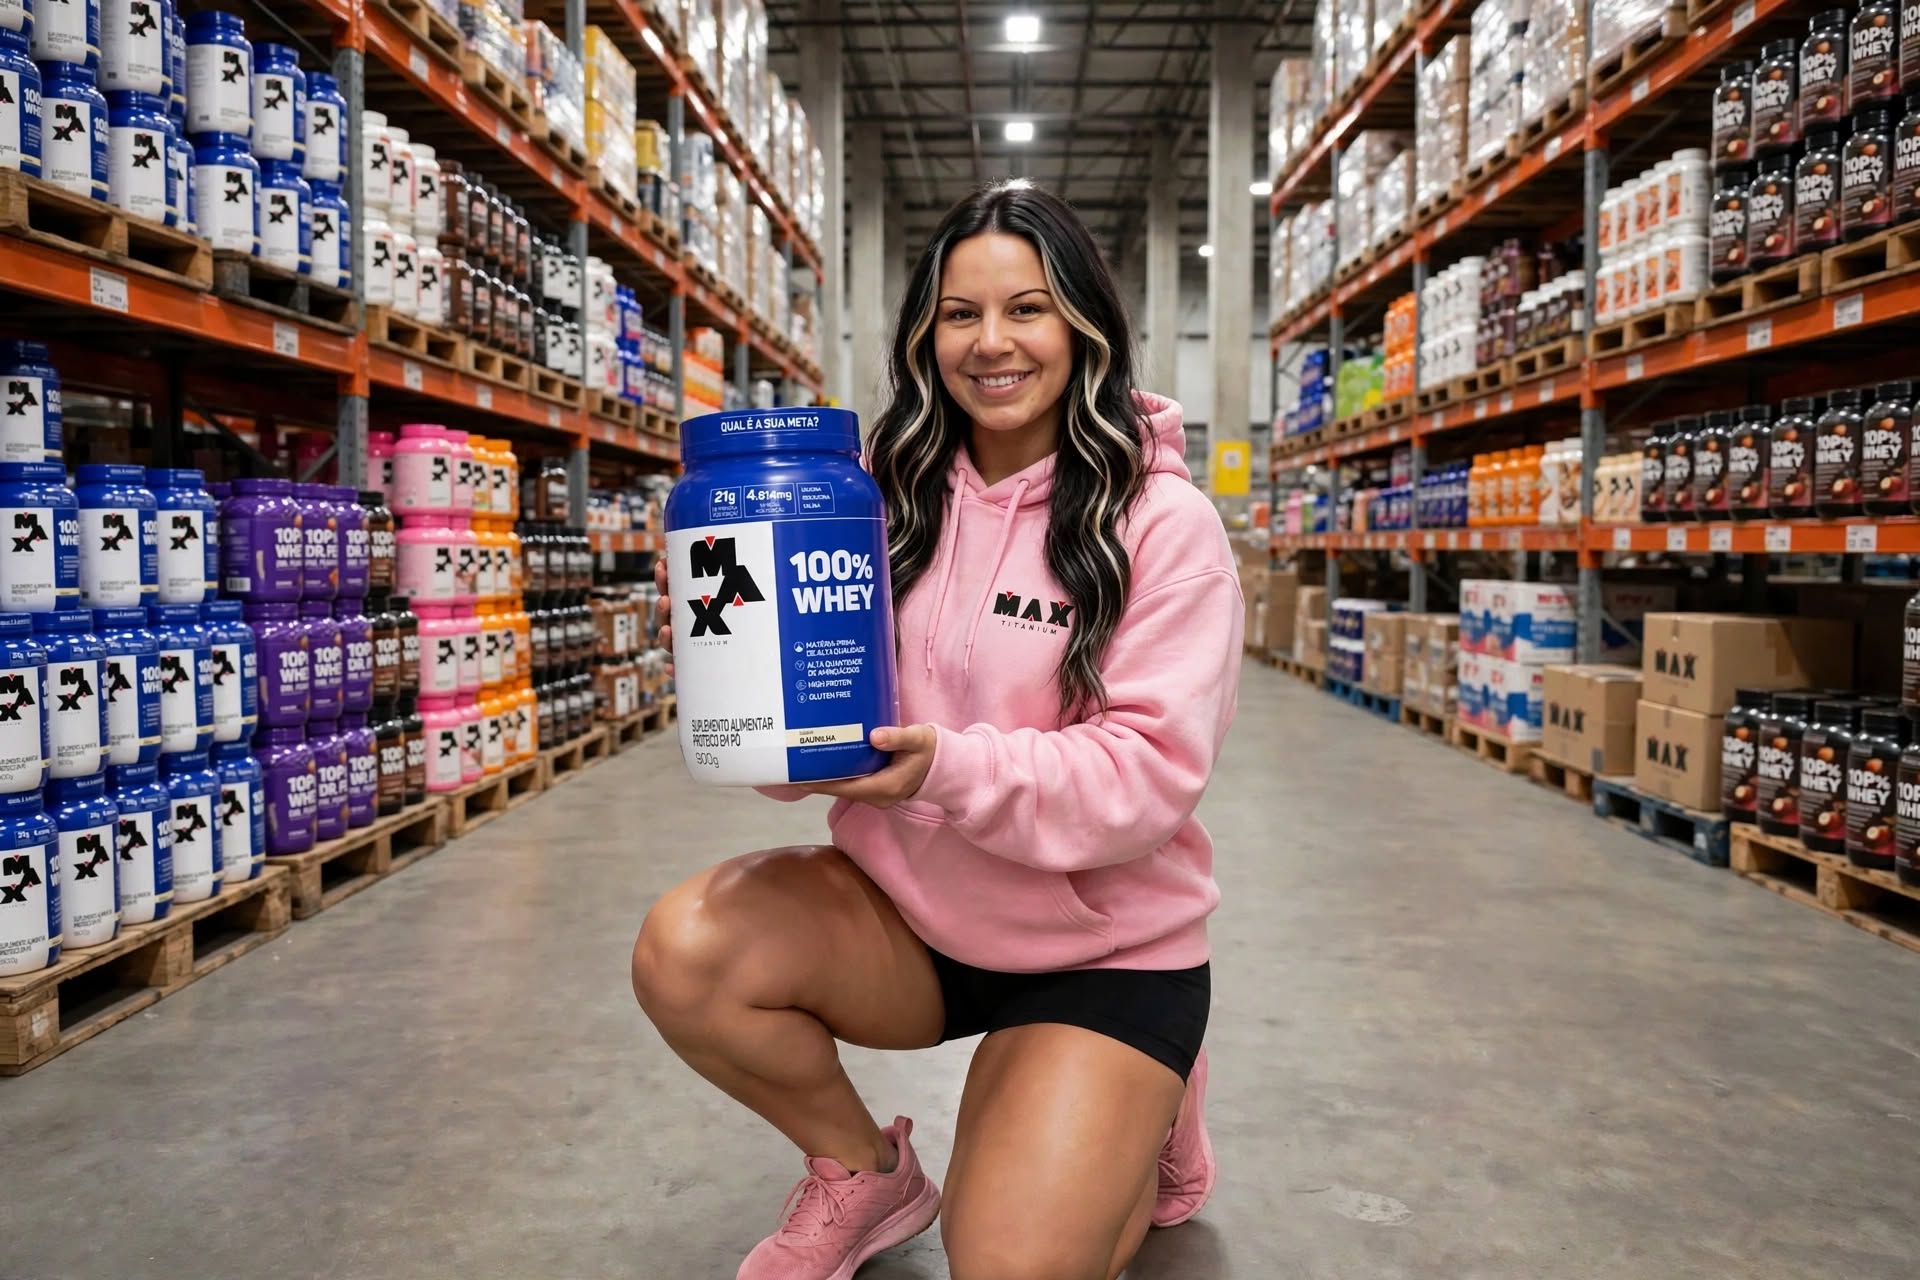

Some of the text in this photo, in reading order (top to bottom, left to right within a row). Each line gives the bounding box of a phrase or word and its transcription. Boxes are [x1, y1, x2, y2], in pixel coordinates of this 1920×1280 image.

[1903, 18, 1920, 39] WH
[1853, 39, 1894, 60] WHEY
[24, 87, 42, 103] 100
[24, 102, 42, 118] WHE
[1896, 151, 1920, 169] WHE
[1844, 168, 1883, 187] WHEY
[720, 416, 819, 432] QUAL É A SUA META?
[1863, 444, 1903, 460] WHEY
[714, 490, 736, 504] 21g
[58, 520, 80, 534] 100
[59, 534, 80, 547] WHE
[789, 549, 874, 582] 100%
[687, 535, 766, 638] MAX
[791, 583, 875, 614] WHEY
[992, 591, 1075, 628] MAX
[1001, 620, 1057, 635] TITANIUM
[1904, 644, 1920, 661] WH
[1655, 648, 1698, 681] MAX
[835, 690, 852, 699] FREE
[1549, 702, 1586, 734] MAX
[1646, 735, 1689, 773] MAX
[1800, 773, 1842, 793] WHEY
[1847, 786, 1892, 806] WHEY
[1897, 800, 1920, 820] WHE
